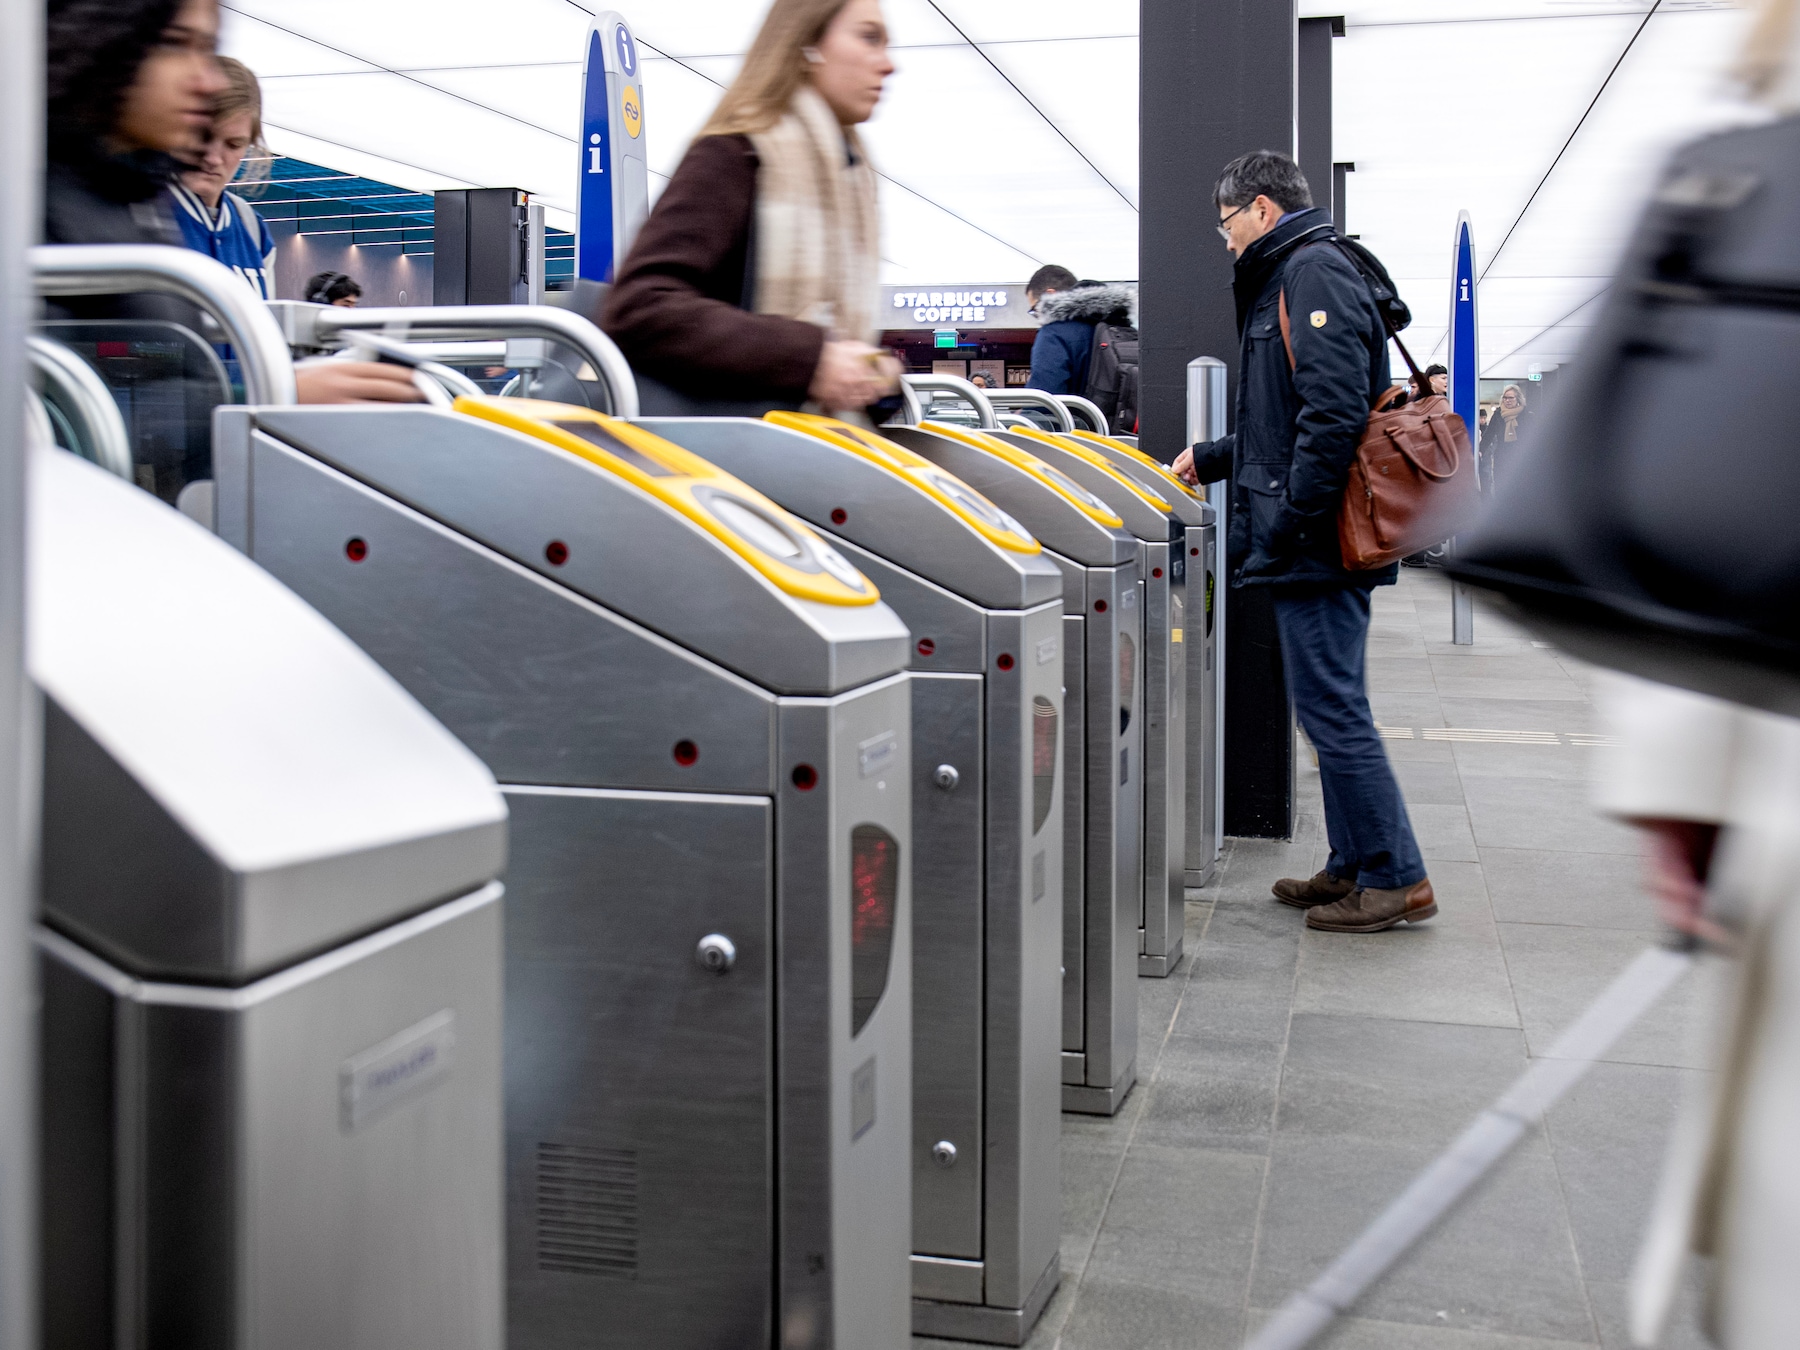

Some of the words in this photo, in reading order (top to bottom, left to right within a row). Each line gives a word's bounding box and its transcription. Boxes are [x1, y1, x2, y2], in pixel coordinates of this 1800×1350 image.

[588, 133, 604, 174] i
[893, 291, 1008, 308] STARBUCKS
[1459, 278, 1470, 302] i
[913, 307, 986, 322] COFFEE
